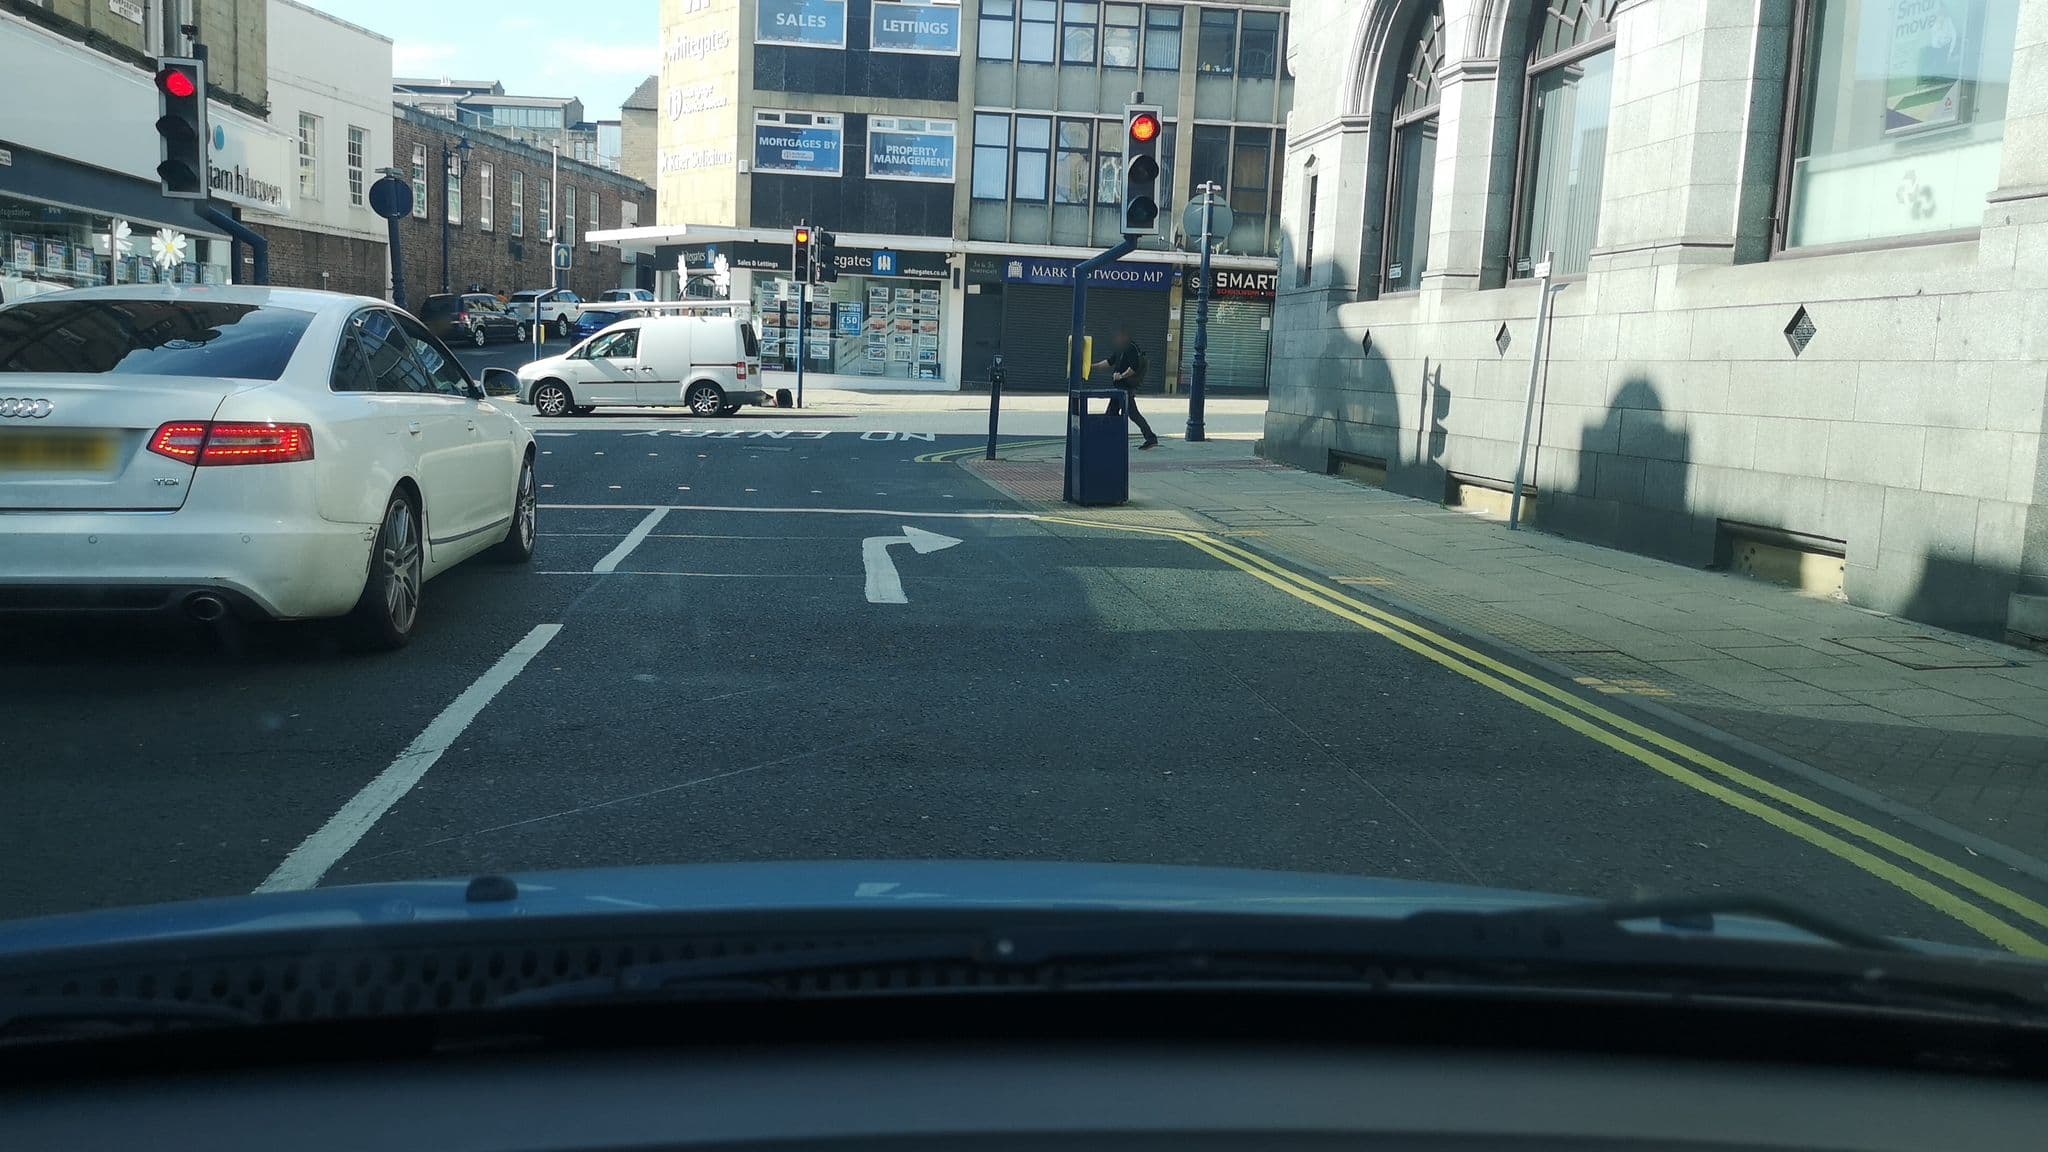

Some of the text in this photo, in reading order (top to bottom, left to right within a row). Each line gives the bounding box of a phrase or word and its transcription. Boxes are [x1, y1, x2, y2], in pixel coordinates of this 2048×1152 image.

[776, 13, 827, 28] SALES
[882, 20, 949, 35] LETTINGS
[1896, 15, 1937, 37] move
[759, 137, 837, 150] MORTGAGES BY
[885, 145, 938, 157] PROPERTY
[873, 155, 951, 168] MANAGEMENT
[236, 163, 244, 196] h
[737, 259, 751, 267] Sales
[757, 260, 779, 268] Lettings
[833, 255, 872, 268] egates
[1031, 265, 1068, 278] MARK
[1143, 271, 1164, 282] MP
[1216, 272, 1277, 290] SMART
[621, 429, 936, 442] NO ENTRY
